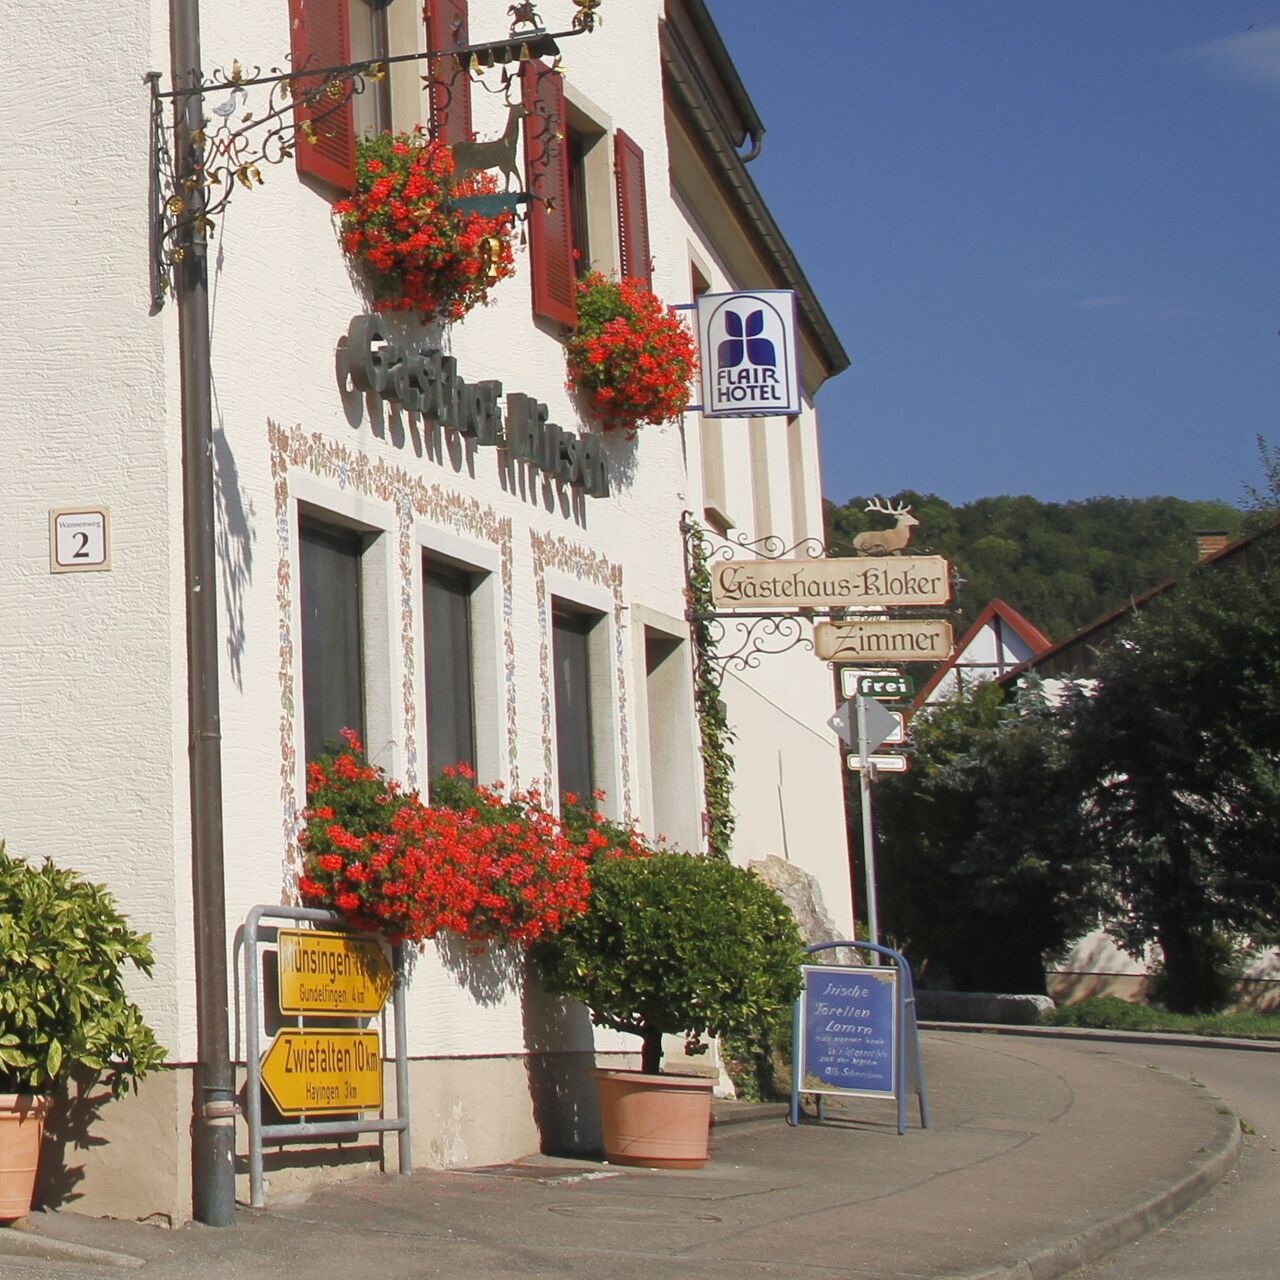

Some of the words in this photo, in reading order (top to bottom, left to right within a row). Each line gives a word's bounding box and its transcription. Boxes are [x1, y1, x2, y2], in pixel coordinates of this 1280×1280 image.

[717, 368, 780, 385] FLAIR
[717, 385, 781, 402] HOTEL
[71, 531, 90, 558] 2
[716, 564, 941, 601] Gästehaus-Kloker
[831, 622, 940, 656] Zimmer
[861, 678, 907, 693] frei
[299, 984, 347, 1007] Gundelfingen
[284, 1039, 351, 1074] Zwiefalten
[306, 1082, 339, 1105] Hayingen
